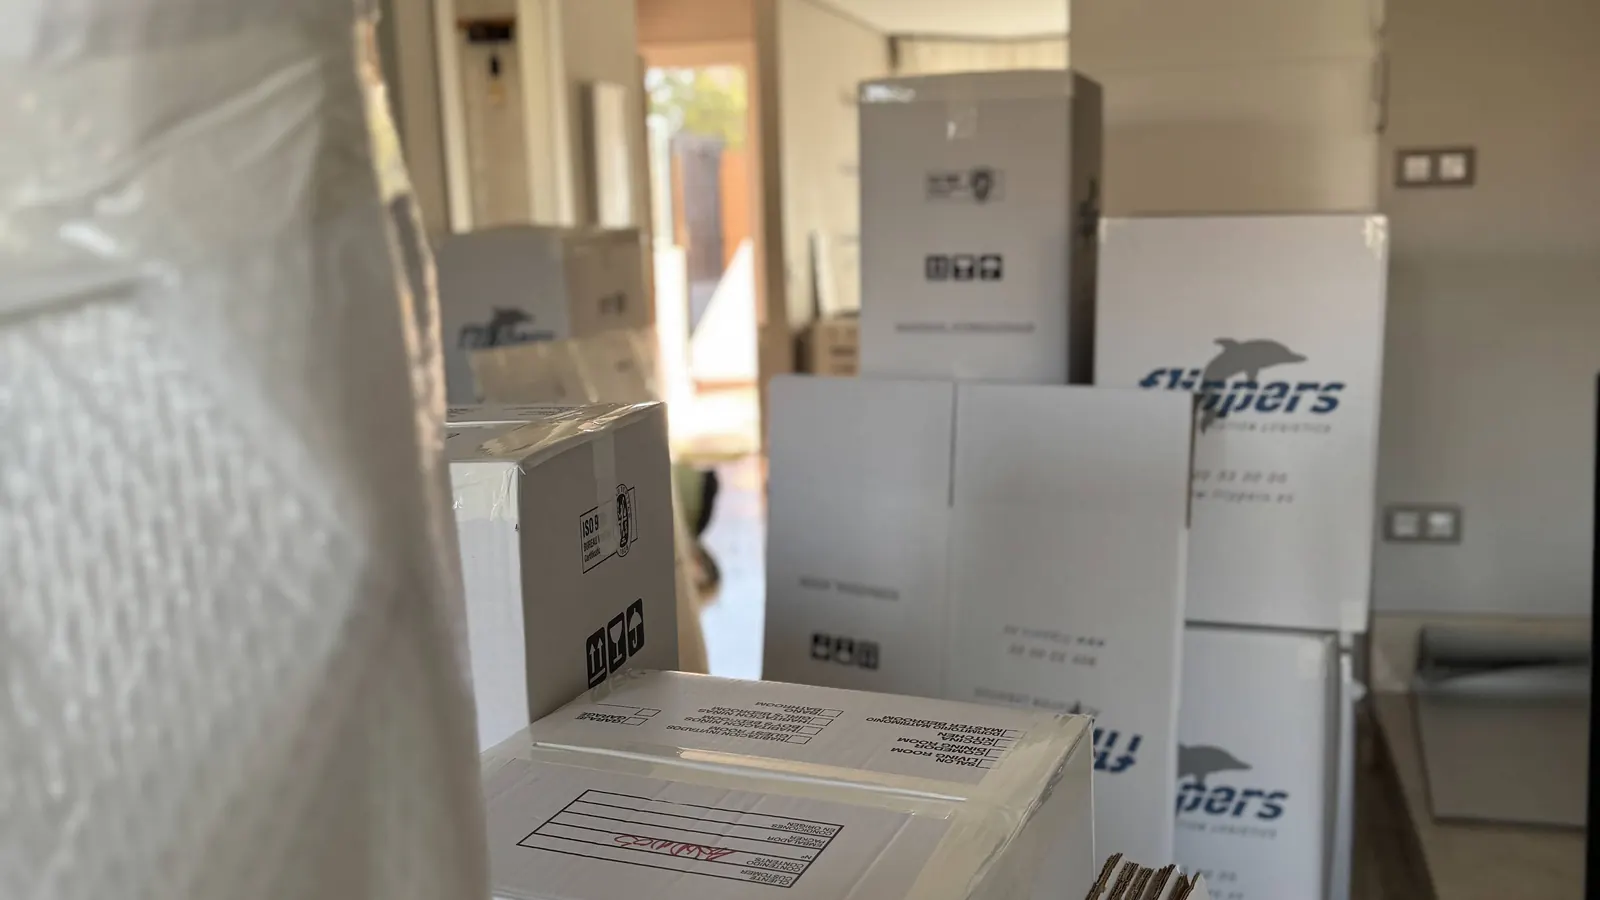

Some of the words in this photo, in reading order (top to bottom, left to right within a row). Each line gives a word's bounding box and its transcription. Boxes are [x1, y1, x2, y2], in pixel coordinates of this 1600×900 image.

[582, 517, 594, 538] ISO
[866, 717, 930, 728] MATRIMONIO
[882, 715, 947, 726] BEDROOM
[933, 724, 1000, 736] DORMITORIO
[950, 722, 1003, 733] MASTER
[897, 737, 935, 746] ROOM
[937, 732, 995, 742] KITCHEN
[941, 736, 992, 746] COCINA
[890, 748, 932, 756] ROOM
[914, 744, 985, 756] COMEDOR
[942, 742, 987, 752] DINING
[936, 753, 978, 762] LIVING
[936, 758, 977, 767] SALON
[1175, 782, 1288, 820] pers
[771, 824, 832, 836] CONDICIONES
[787, 822, 821, 830] ORIGEN
[767, 836, 822, 847] EMBALADOR
[790, 836, 826, 844] PACKER
[746, 860, 800, 872] CONTENIDO
[754, 858, 804, 868] CONTENTS
[740, 870, 792, 881] CUSTOMER
[749, 876, 789, 885] CLIENTE
